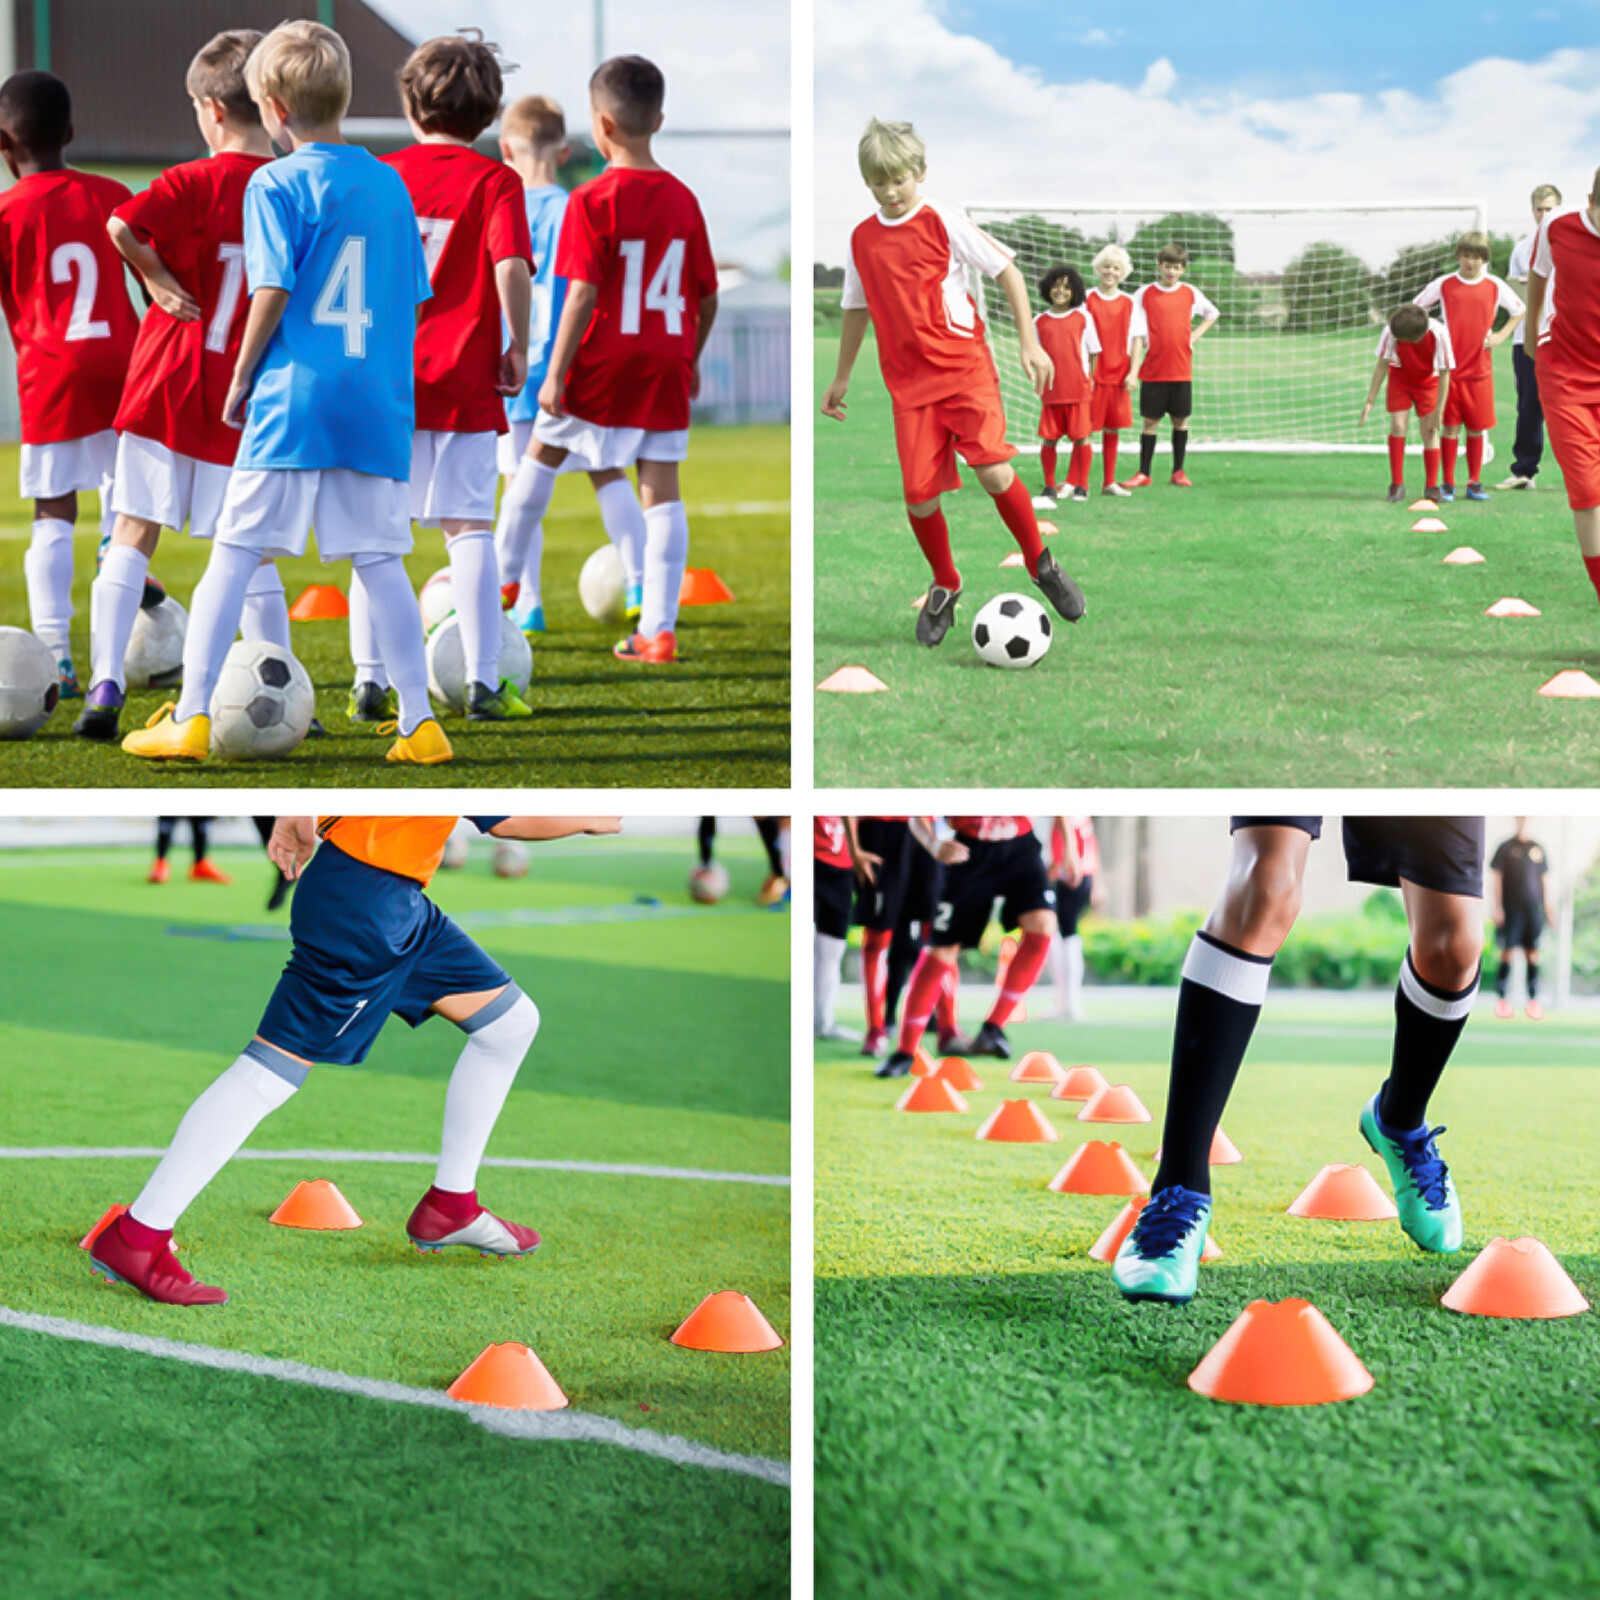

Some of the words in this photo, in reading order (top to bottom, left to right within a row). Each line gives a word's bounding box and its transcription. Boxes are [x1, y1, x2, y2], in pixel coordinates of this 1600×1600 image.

[51, 242, 111, 341] 2
[311, 235, 373, 359] 4
[619, 238, 686, 335] 14
[933, 901, 953, 931] 2
